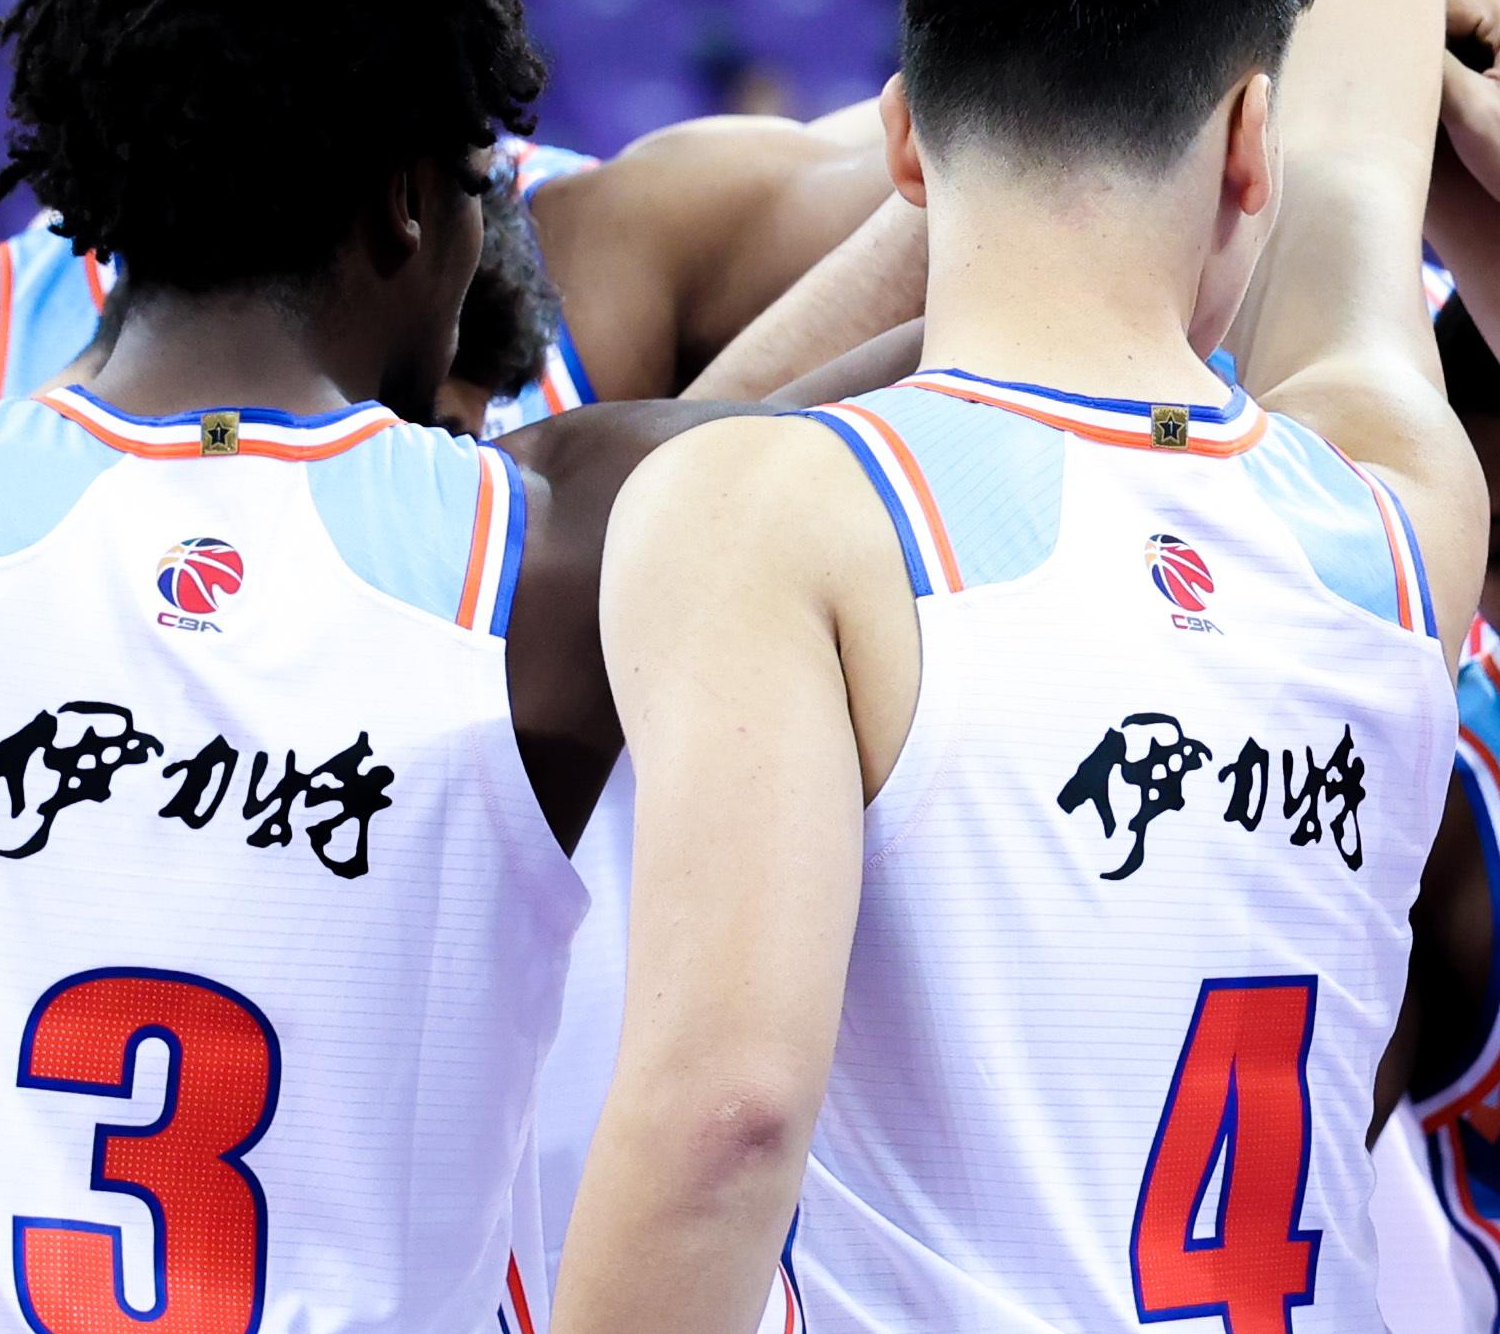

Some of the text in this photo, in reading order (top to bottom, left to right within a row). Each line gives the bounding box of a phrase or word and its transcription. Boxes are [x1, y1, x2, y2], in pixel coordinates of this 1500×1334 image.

[157, 612, 223, 633] CBA
[1171, 614, 1224, 635] CBA
[1057, 712, 1366, 880] 伊力特
